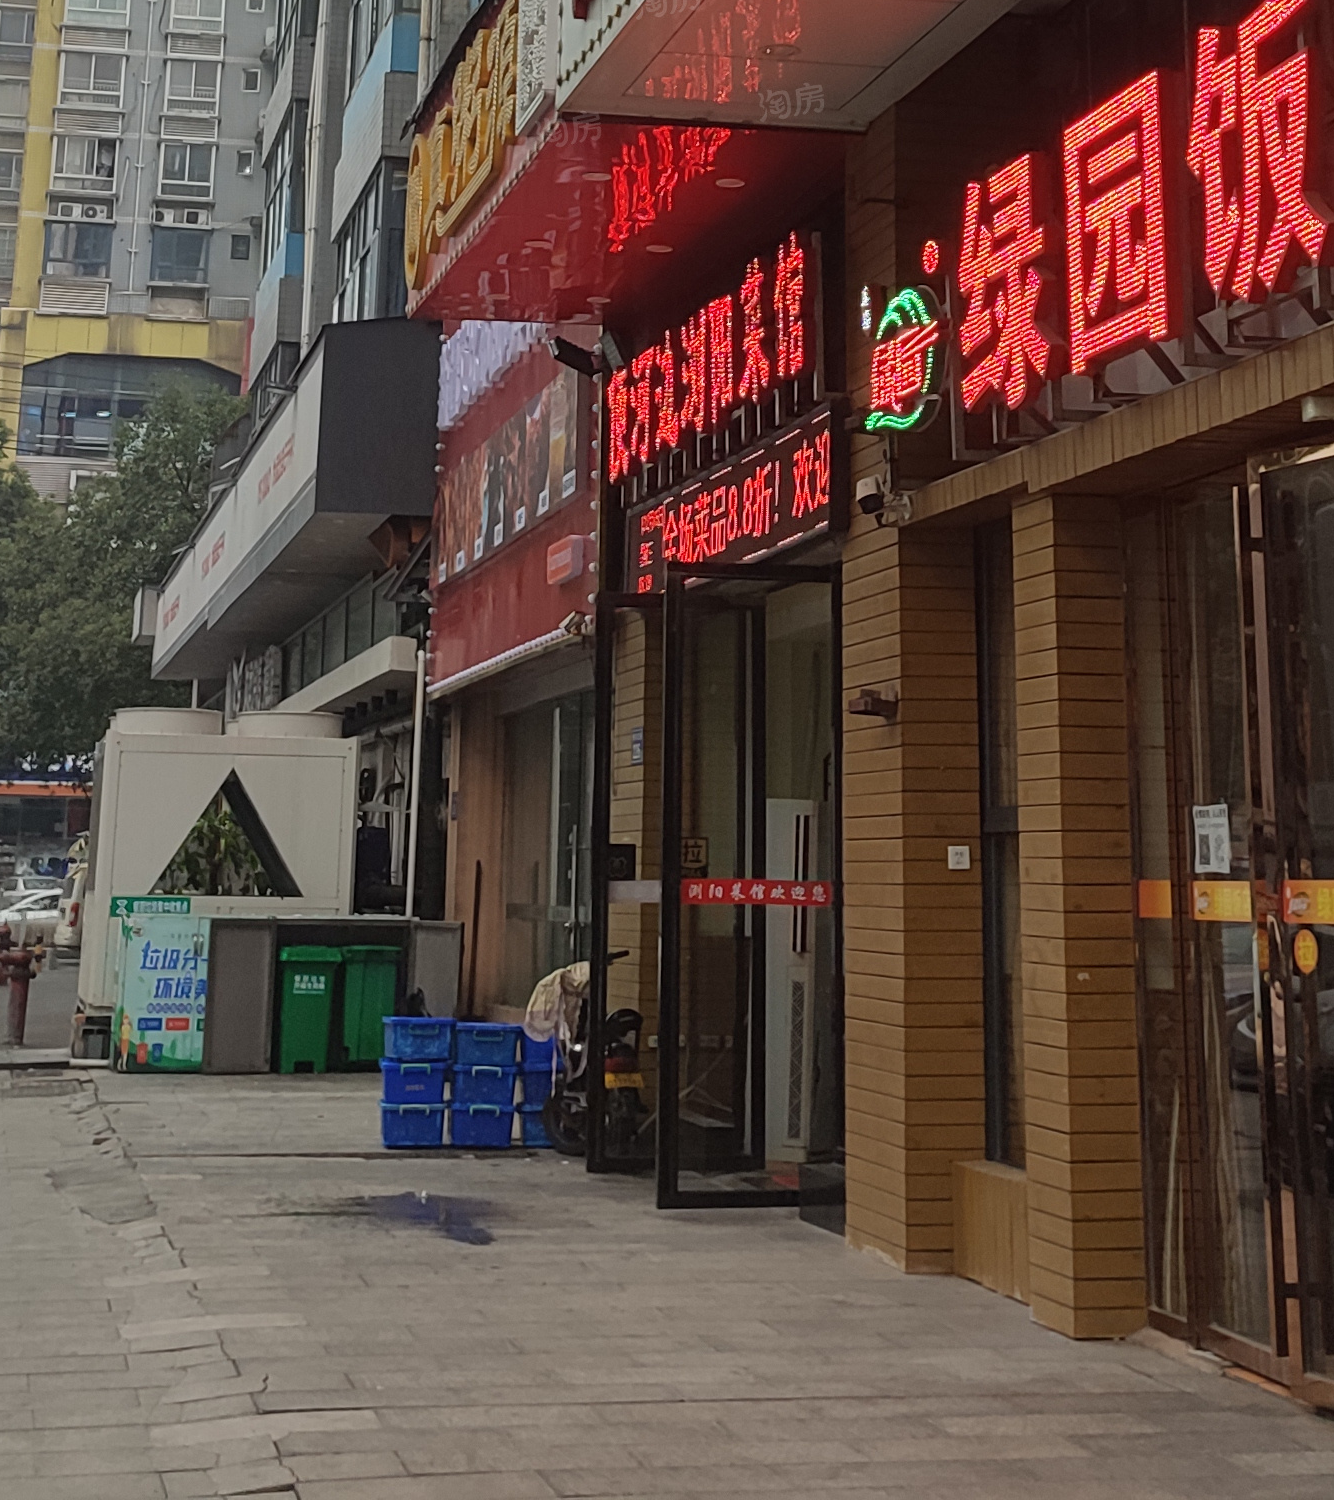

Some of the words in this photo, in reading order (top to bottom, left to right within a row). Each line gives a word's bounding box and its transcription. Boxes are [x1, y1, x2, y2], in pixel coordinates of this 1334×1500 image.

[607, 229, 805, 485] 便河边浏阳菜馆
[682, 839, 704, 864] 拉
[687, 881, 827, 903] 浏阳菜馆欢迎您
[139, 940, 209, 971] 垃圾分
